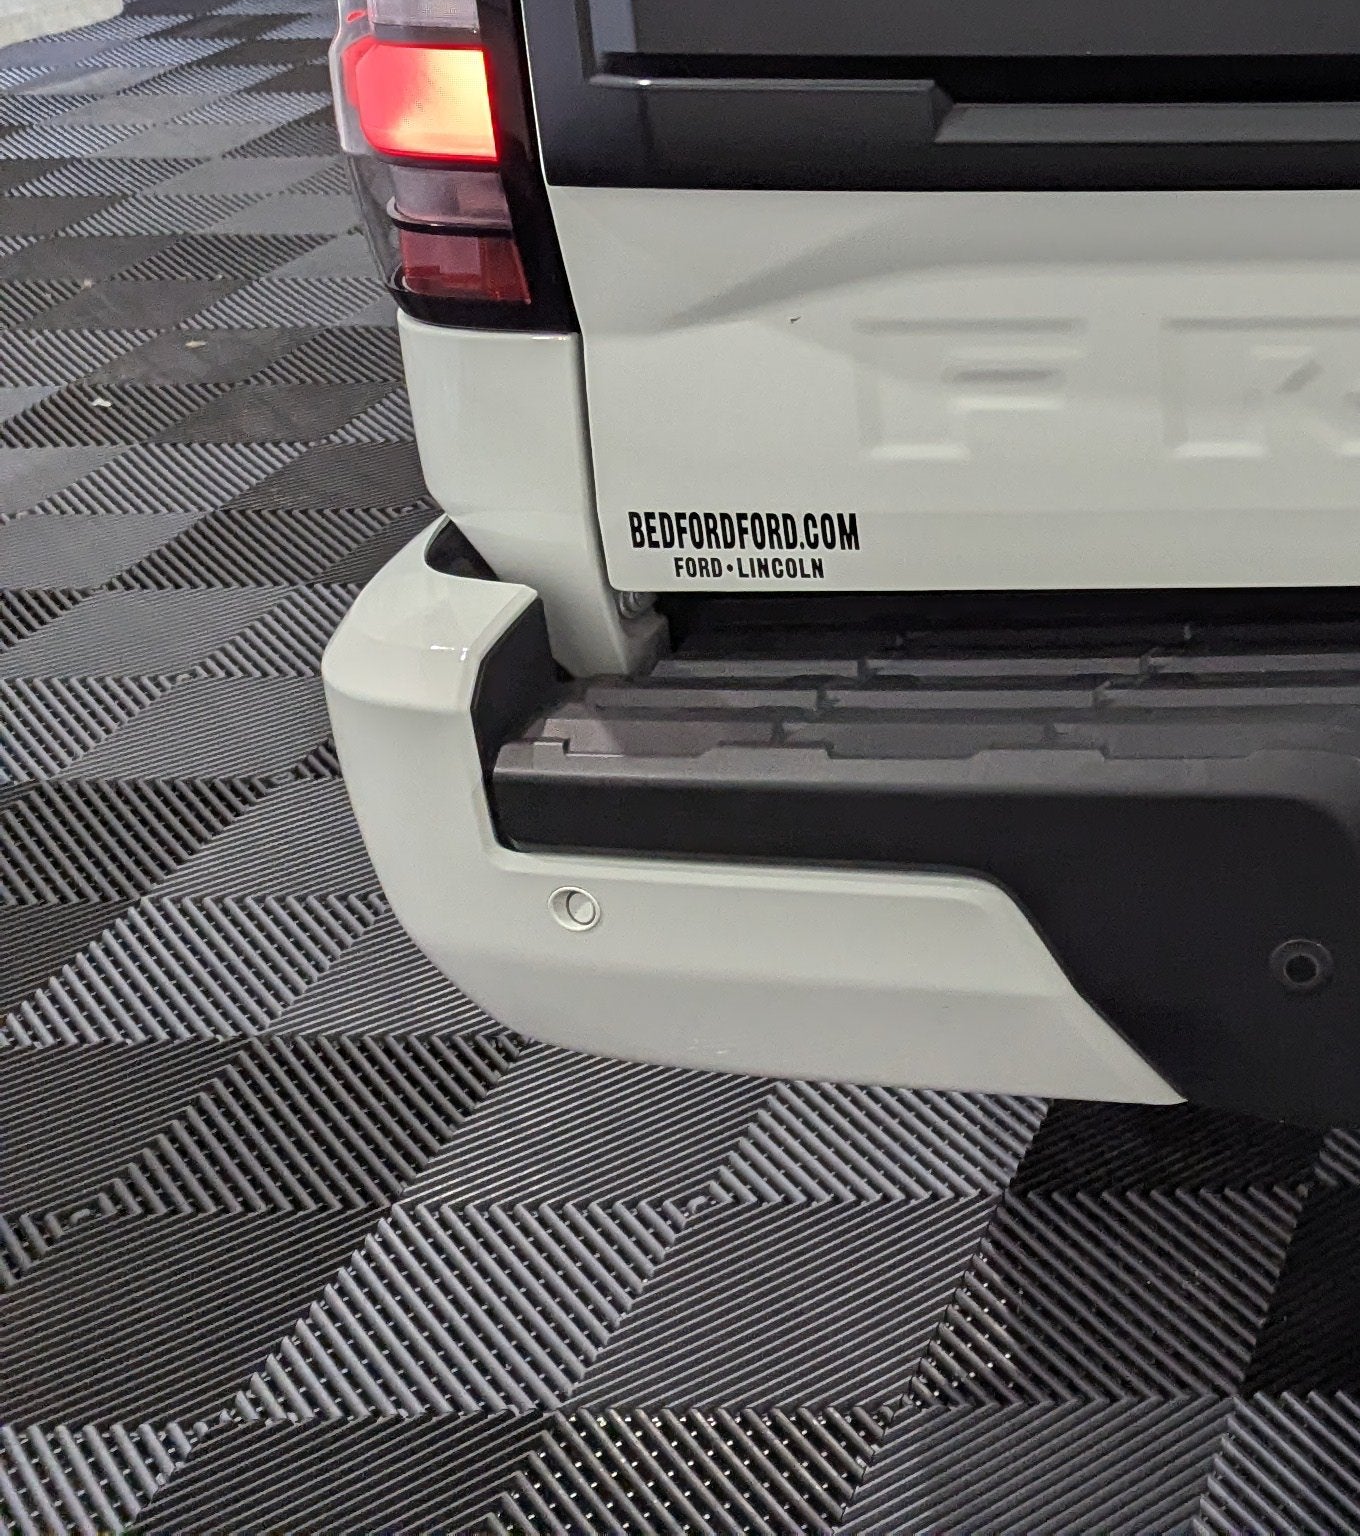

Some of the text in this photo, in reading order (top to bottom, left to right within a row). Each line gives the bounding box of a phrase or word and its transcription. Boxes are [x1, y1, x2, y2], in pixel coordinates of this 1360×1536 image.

[627, 511, 860, 551] BEDFORDFORD.COM
[674, 557, 825, 579] FORD LINCOLN
